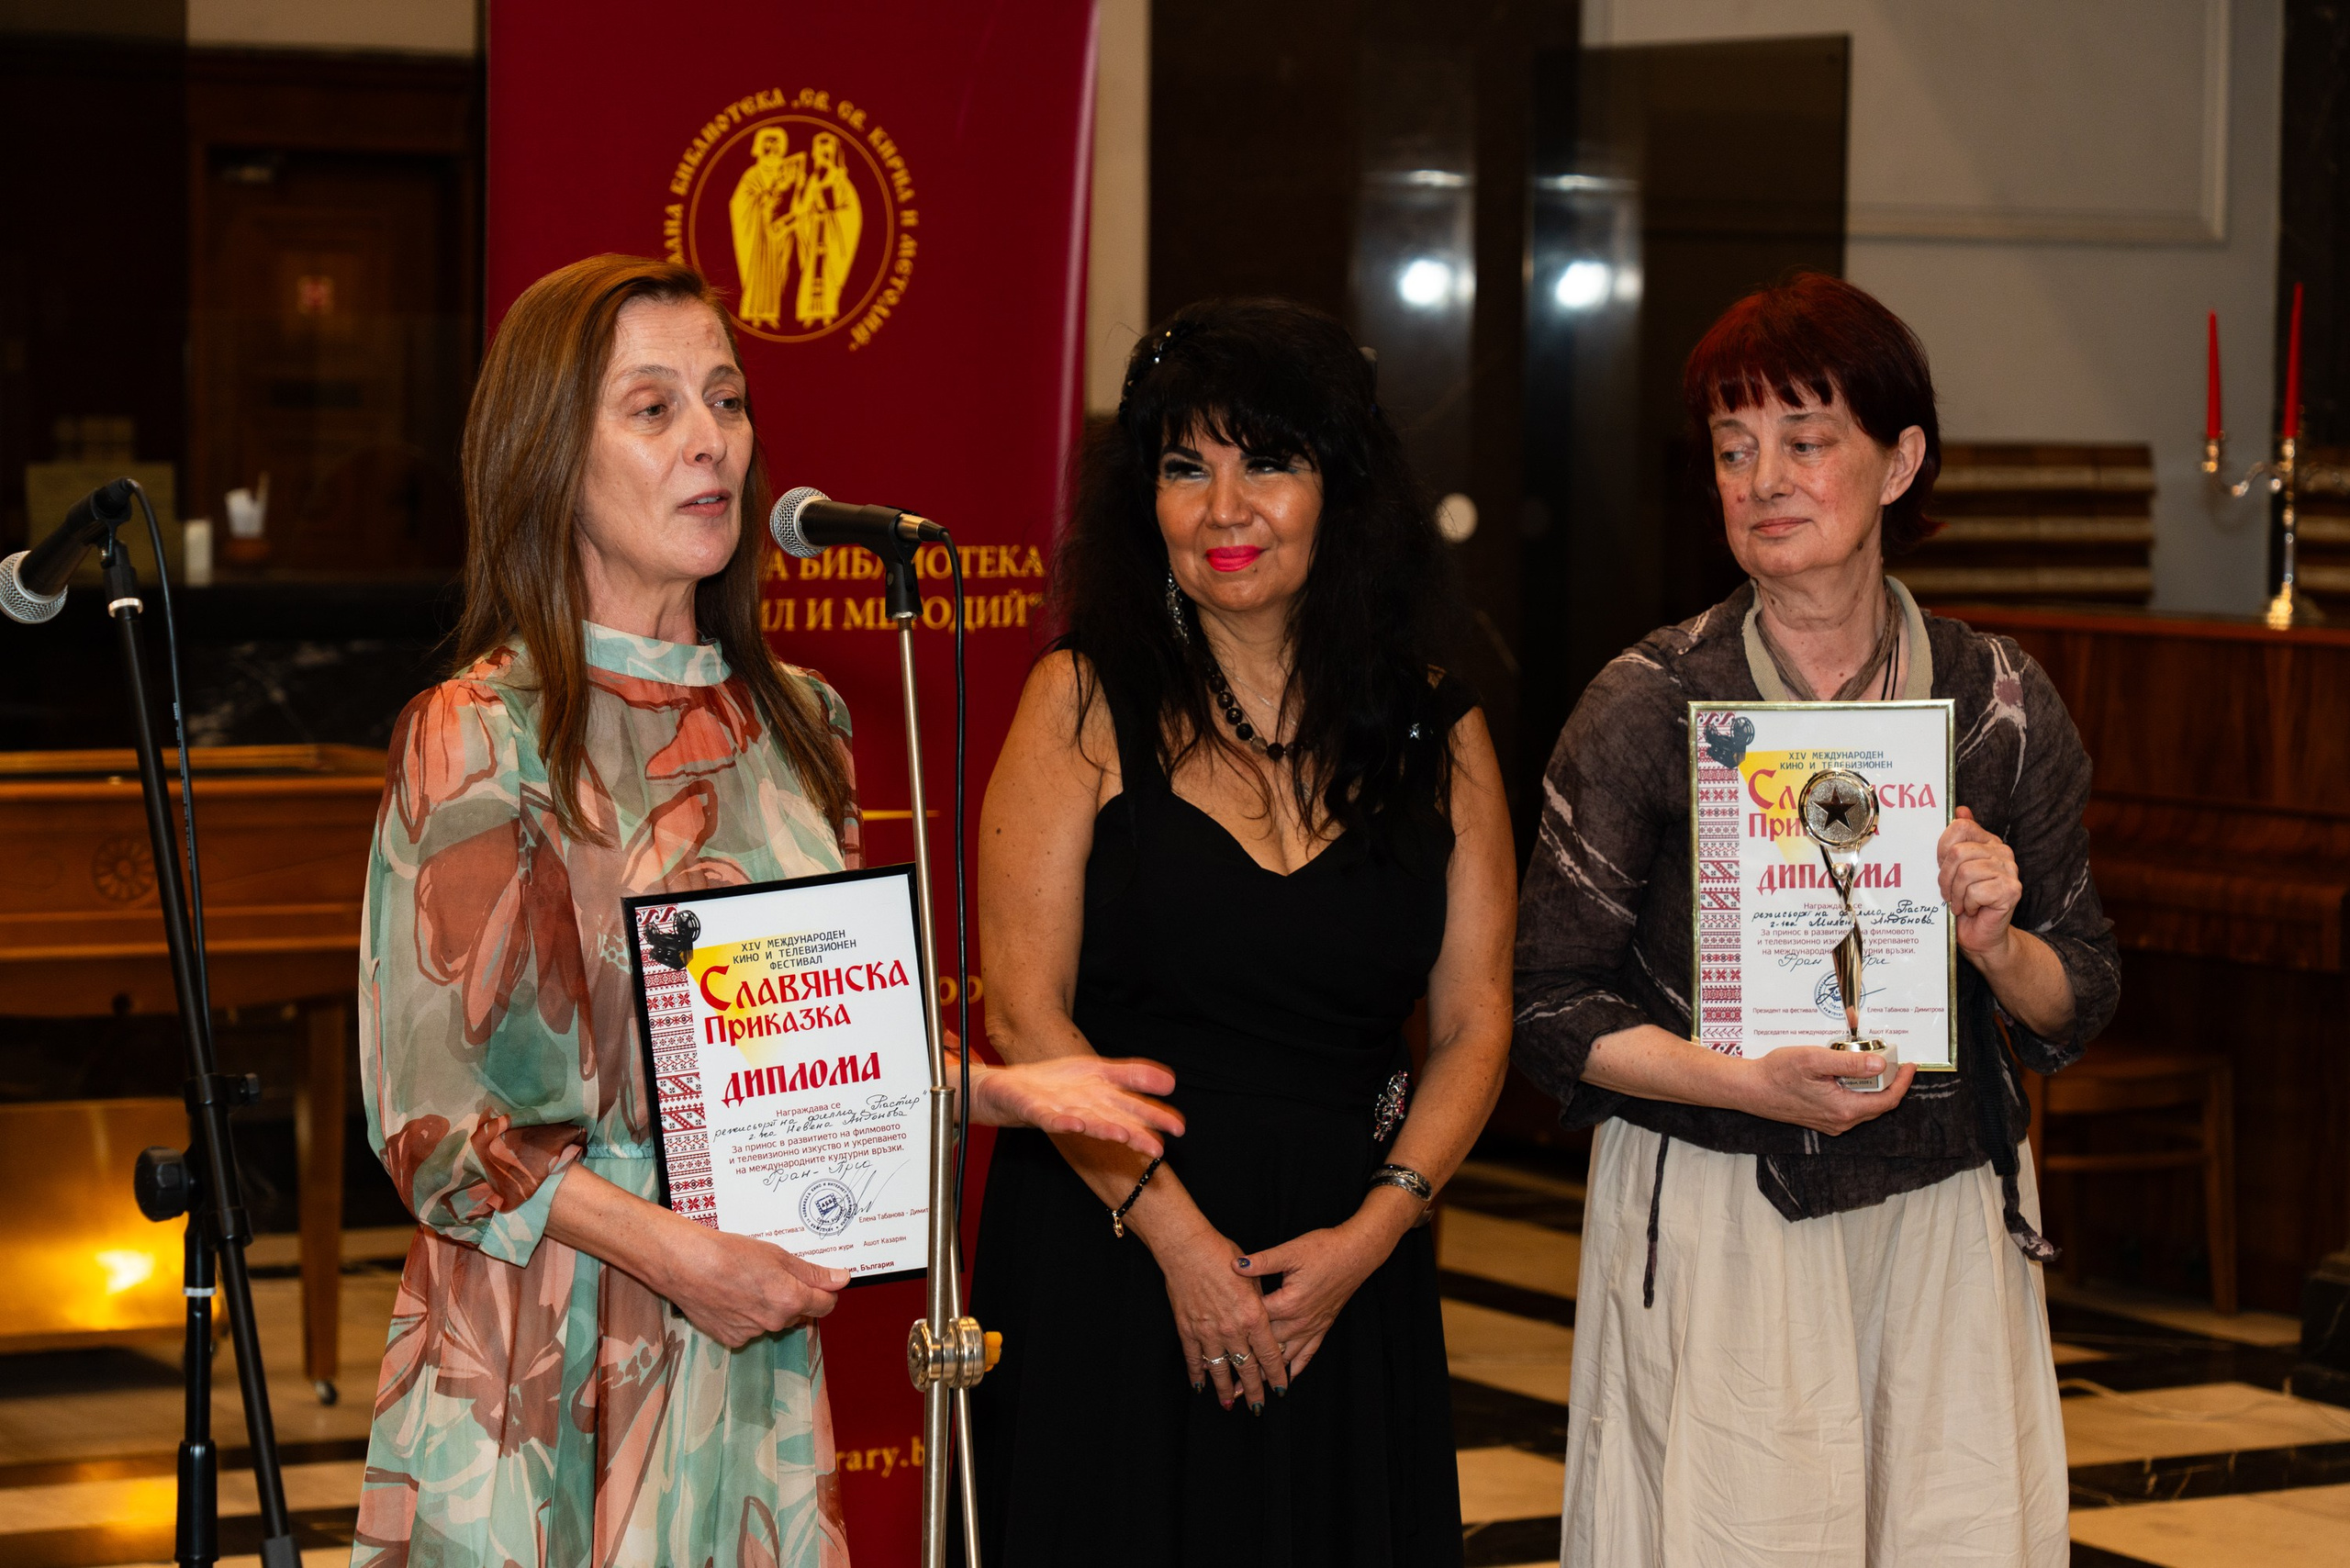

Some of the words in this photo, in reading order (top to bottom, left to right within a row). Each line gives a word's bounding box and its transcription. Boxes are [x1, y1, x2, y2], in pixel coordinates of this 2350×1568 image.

[799, 545, 1045, 580] БИБОТЕКА
[806, 599, 834, 631] И
[1788, 752, 1807, 760] XIV
[1812, 750, 1884, 760] МЕЖДУНАРОДЕН
[1780, 761, 1804, 770] КИНО
[1808, 917, 1852, 927] Милен
[1773, 929, 1801, 937] принос
[1811, 929, 1849, 937] развитие
[1870, 927, 1915, 936] филмовото
[741, 939, 761, 952] XIV
[767, 929, 845, 948] МЕЖДУНАРОДЕН
[1869, 937, 1919, 946] укрепването
[733, 952, 759, 965] КИНО
[766, 949, 773, 959] И
[778, 939, 857, 958] ТЕЛЕВИЗИОНЕН
[1774, 947, 1833, 957] международни
[769, 956, 822, 970] ФЕСТИВАЛ
[776, 1104, 828, 1117] Награждава
[732, 1146, 743, 1154] За
[745, 1140, 777, 1152] принос
[788, 1132, 837, 1146] развитието
[853, 1124, 901, 1137] филмовото
[737, 1148, 800, 1163] телевизионно
[802, 1142, 841, 1154] изкуство
[852, 1132, 907, 1148] укрепването
[749, 1156, 825, 1173] международните
[828, 1148, 869, 1163] културни
[871, 1144, 904, 1157] връзки.
[878, 1211, 904, 1222] Табанова
[838, 1244, 854, 1252] жури
[880, 1236, 907, 1246] Казарян
[860, 1260, 894, 1272] България
